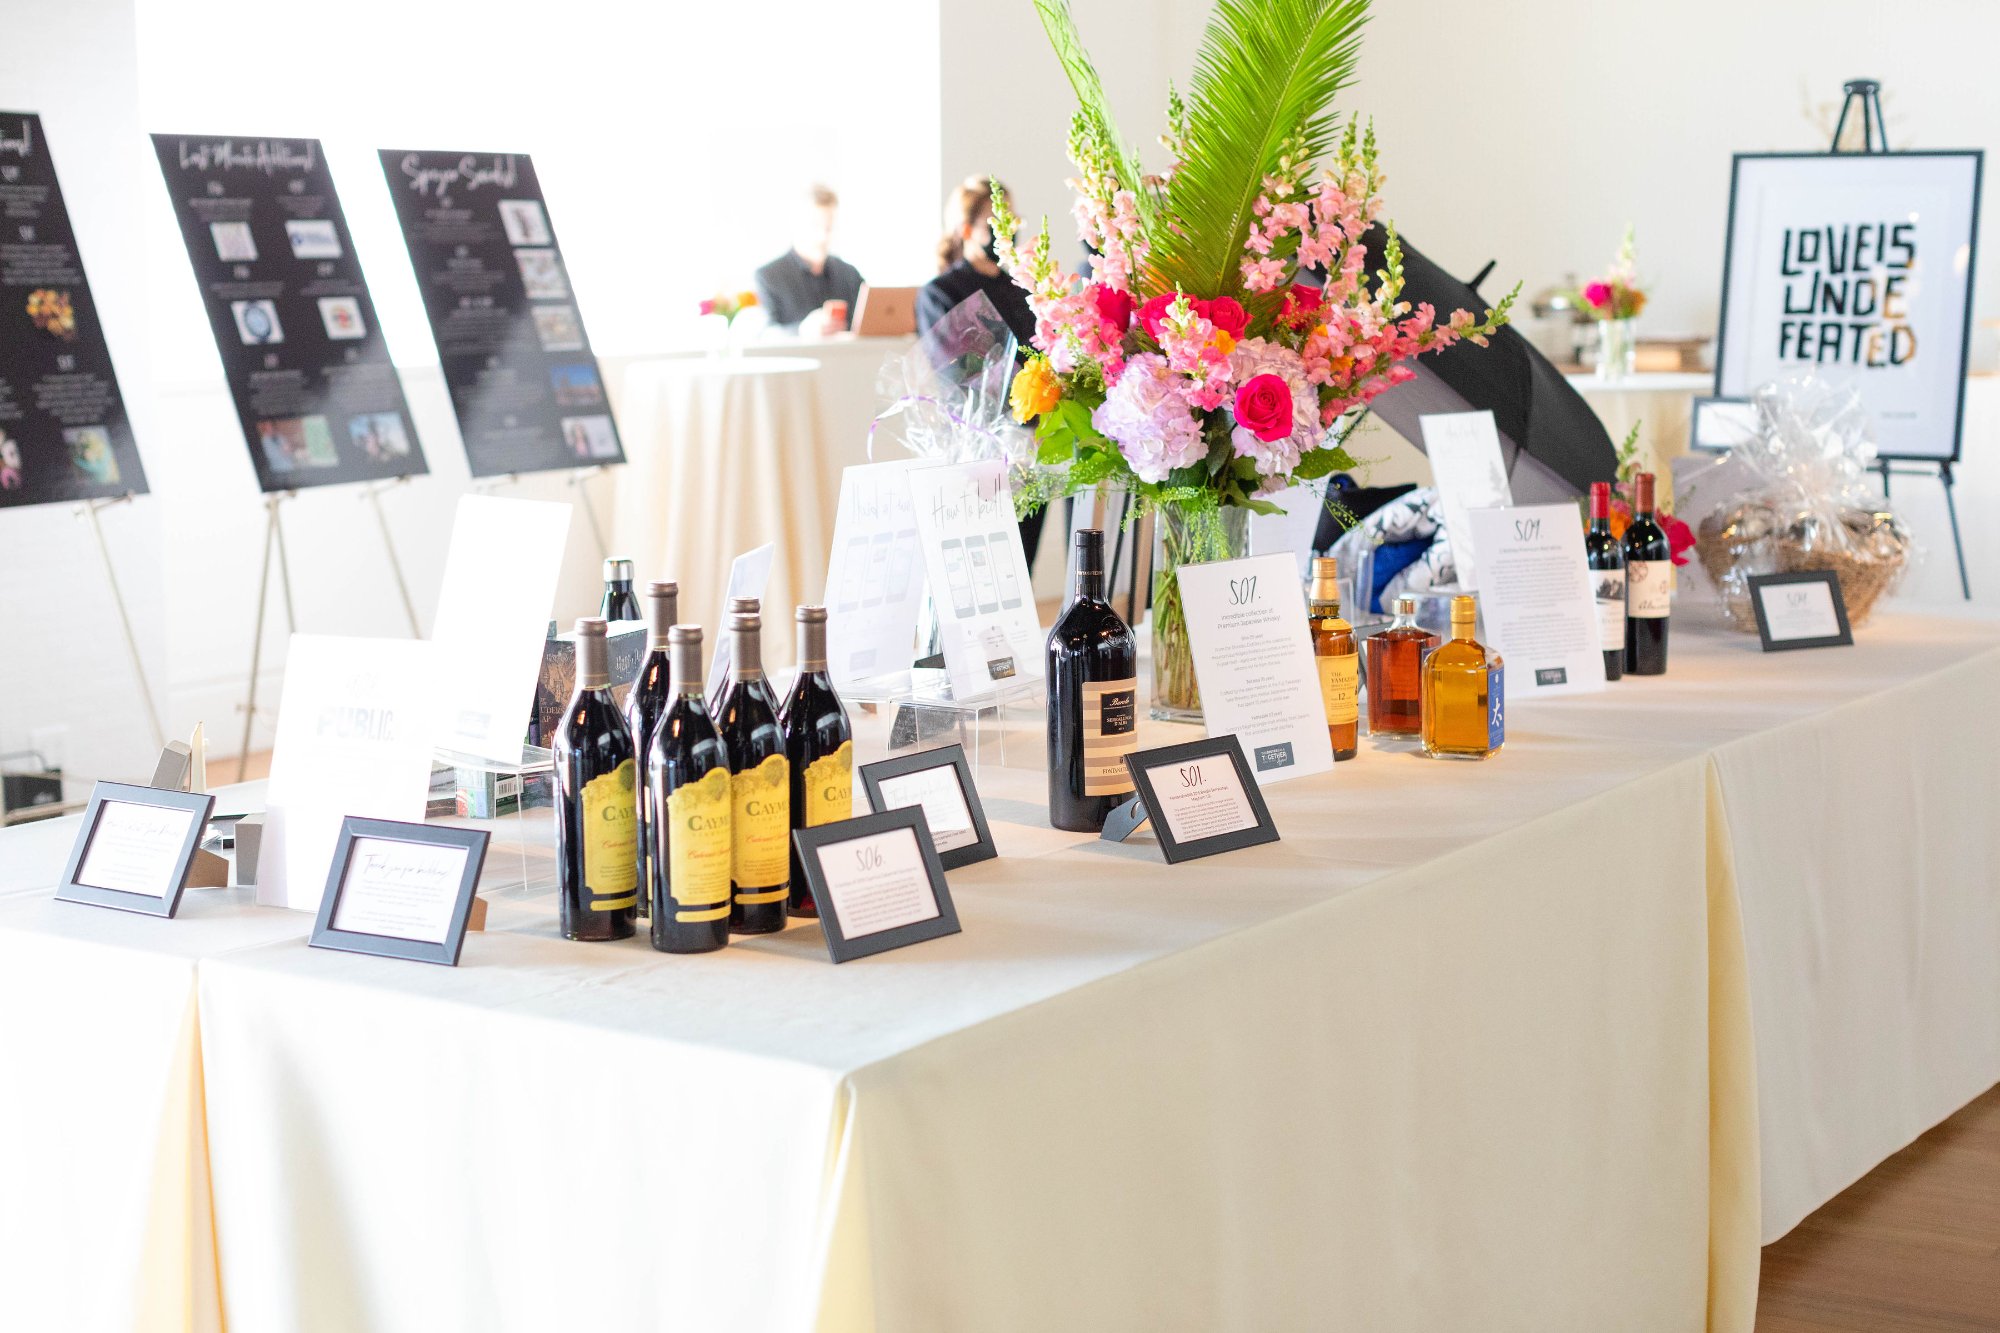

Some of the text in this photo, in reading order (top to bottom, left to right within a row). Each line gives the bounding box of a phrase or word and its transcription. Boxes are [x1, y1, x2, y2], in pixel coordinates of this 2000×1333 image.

[1779, 321, 1917, 368] FEATED
[932, 486, 960, 531] How
[1229, 575, 1262, 605] S07.
[1338, 692, 1346, 701] 12
[1180, 765, 1207, 788] S01.
[856, 847, 886, 871] S06.
